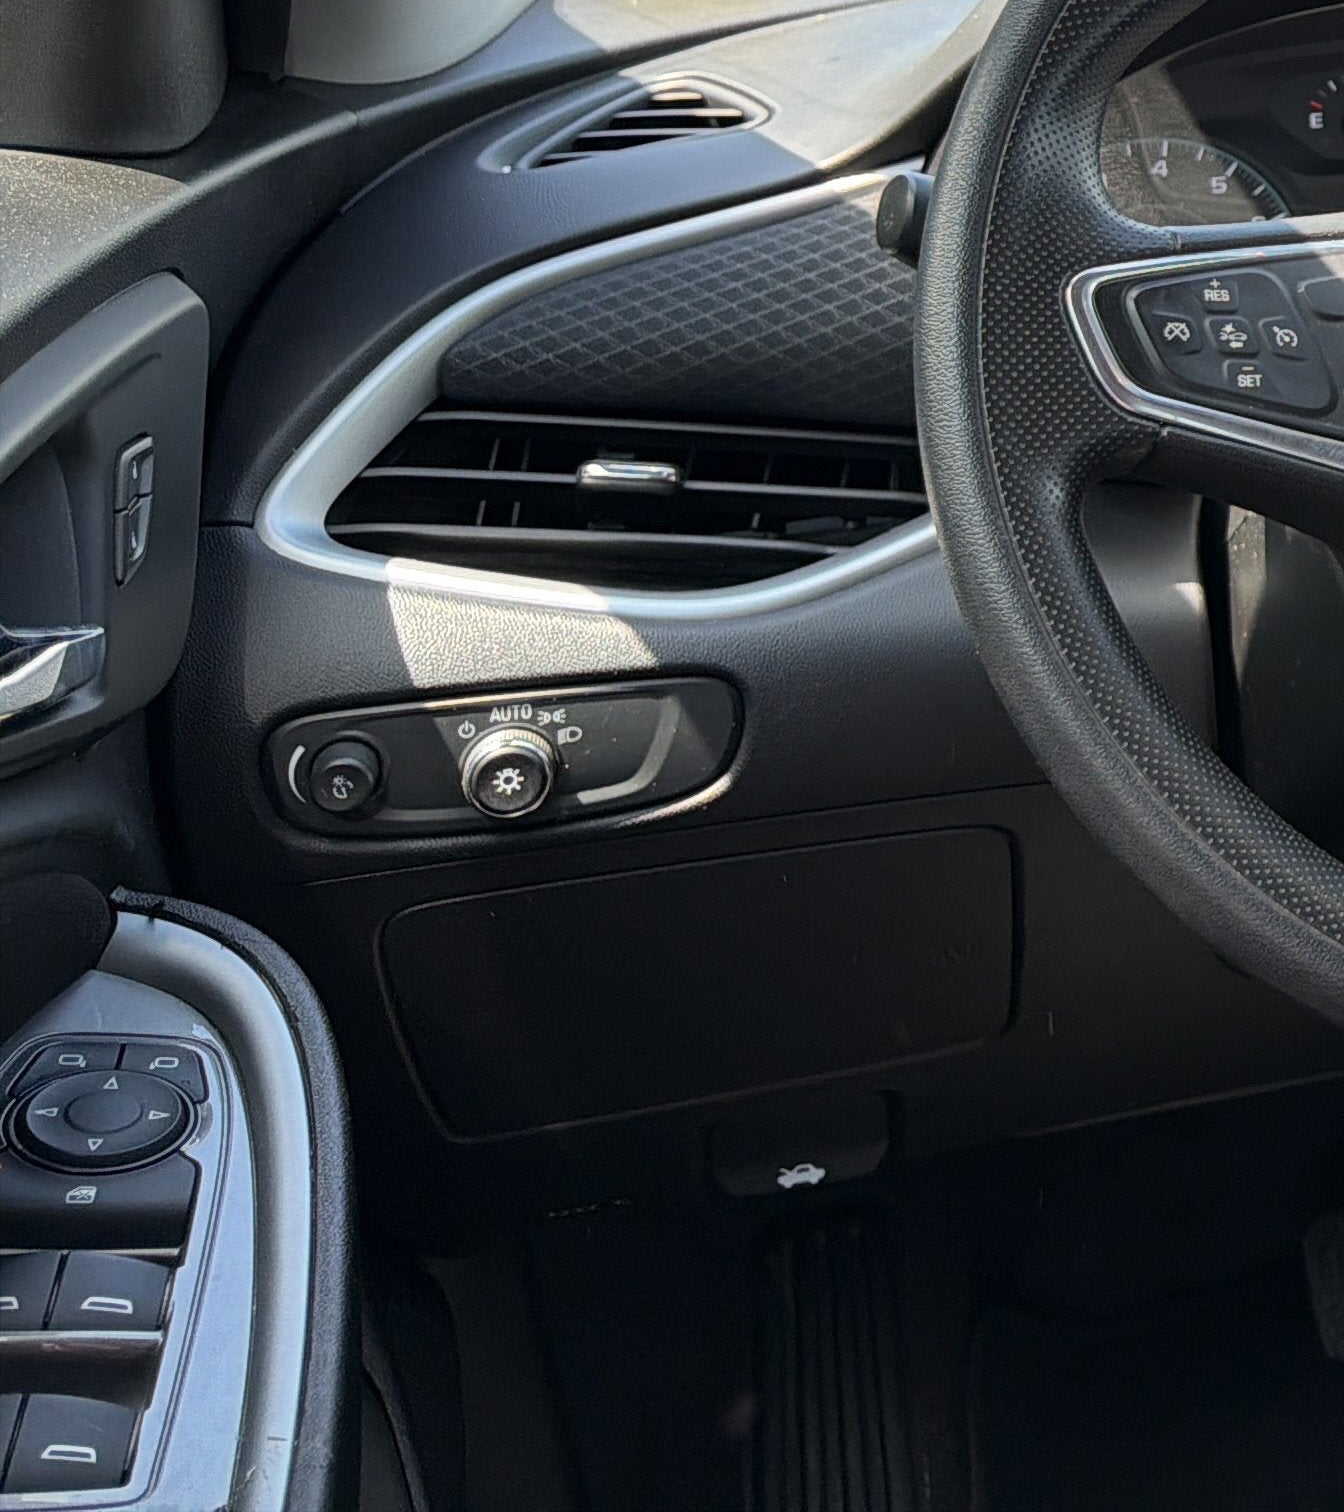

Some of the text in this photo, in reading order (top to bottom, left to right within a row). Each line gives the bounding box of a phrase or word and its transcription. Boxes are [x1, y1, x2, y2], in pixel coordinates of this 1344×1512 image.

[1308, 111, 1324, 130] E
[1151, 159, 1229, 195] 4 5
[1203, 288, 1232, 304] RES
[1236, 373, 1263, 389] SET
[488, 702, 533, 724] AUTO
